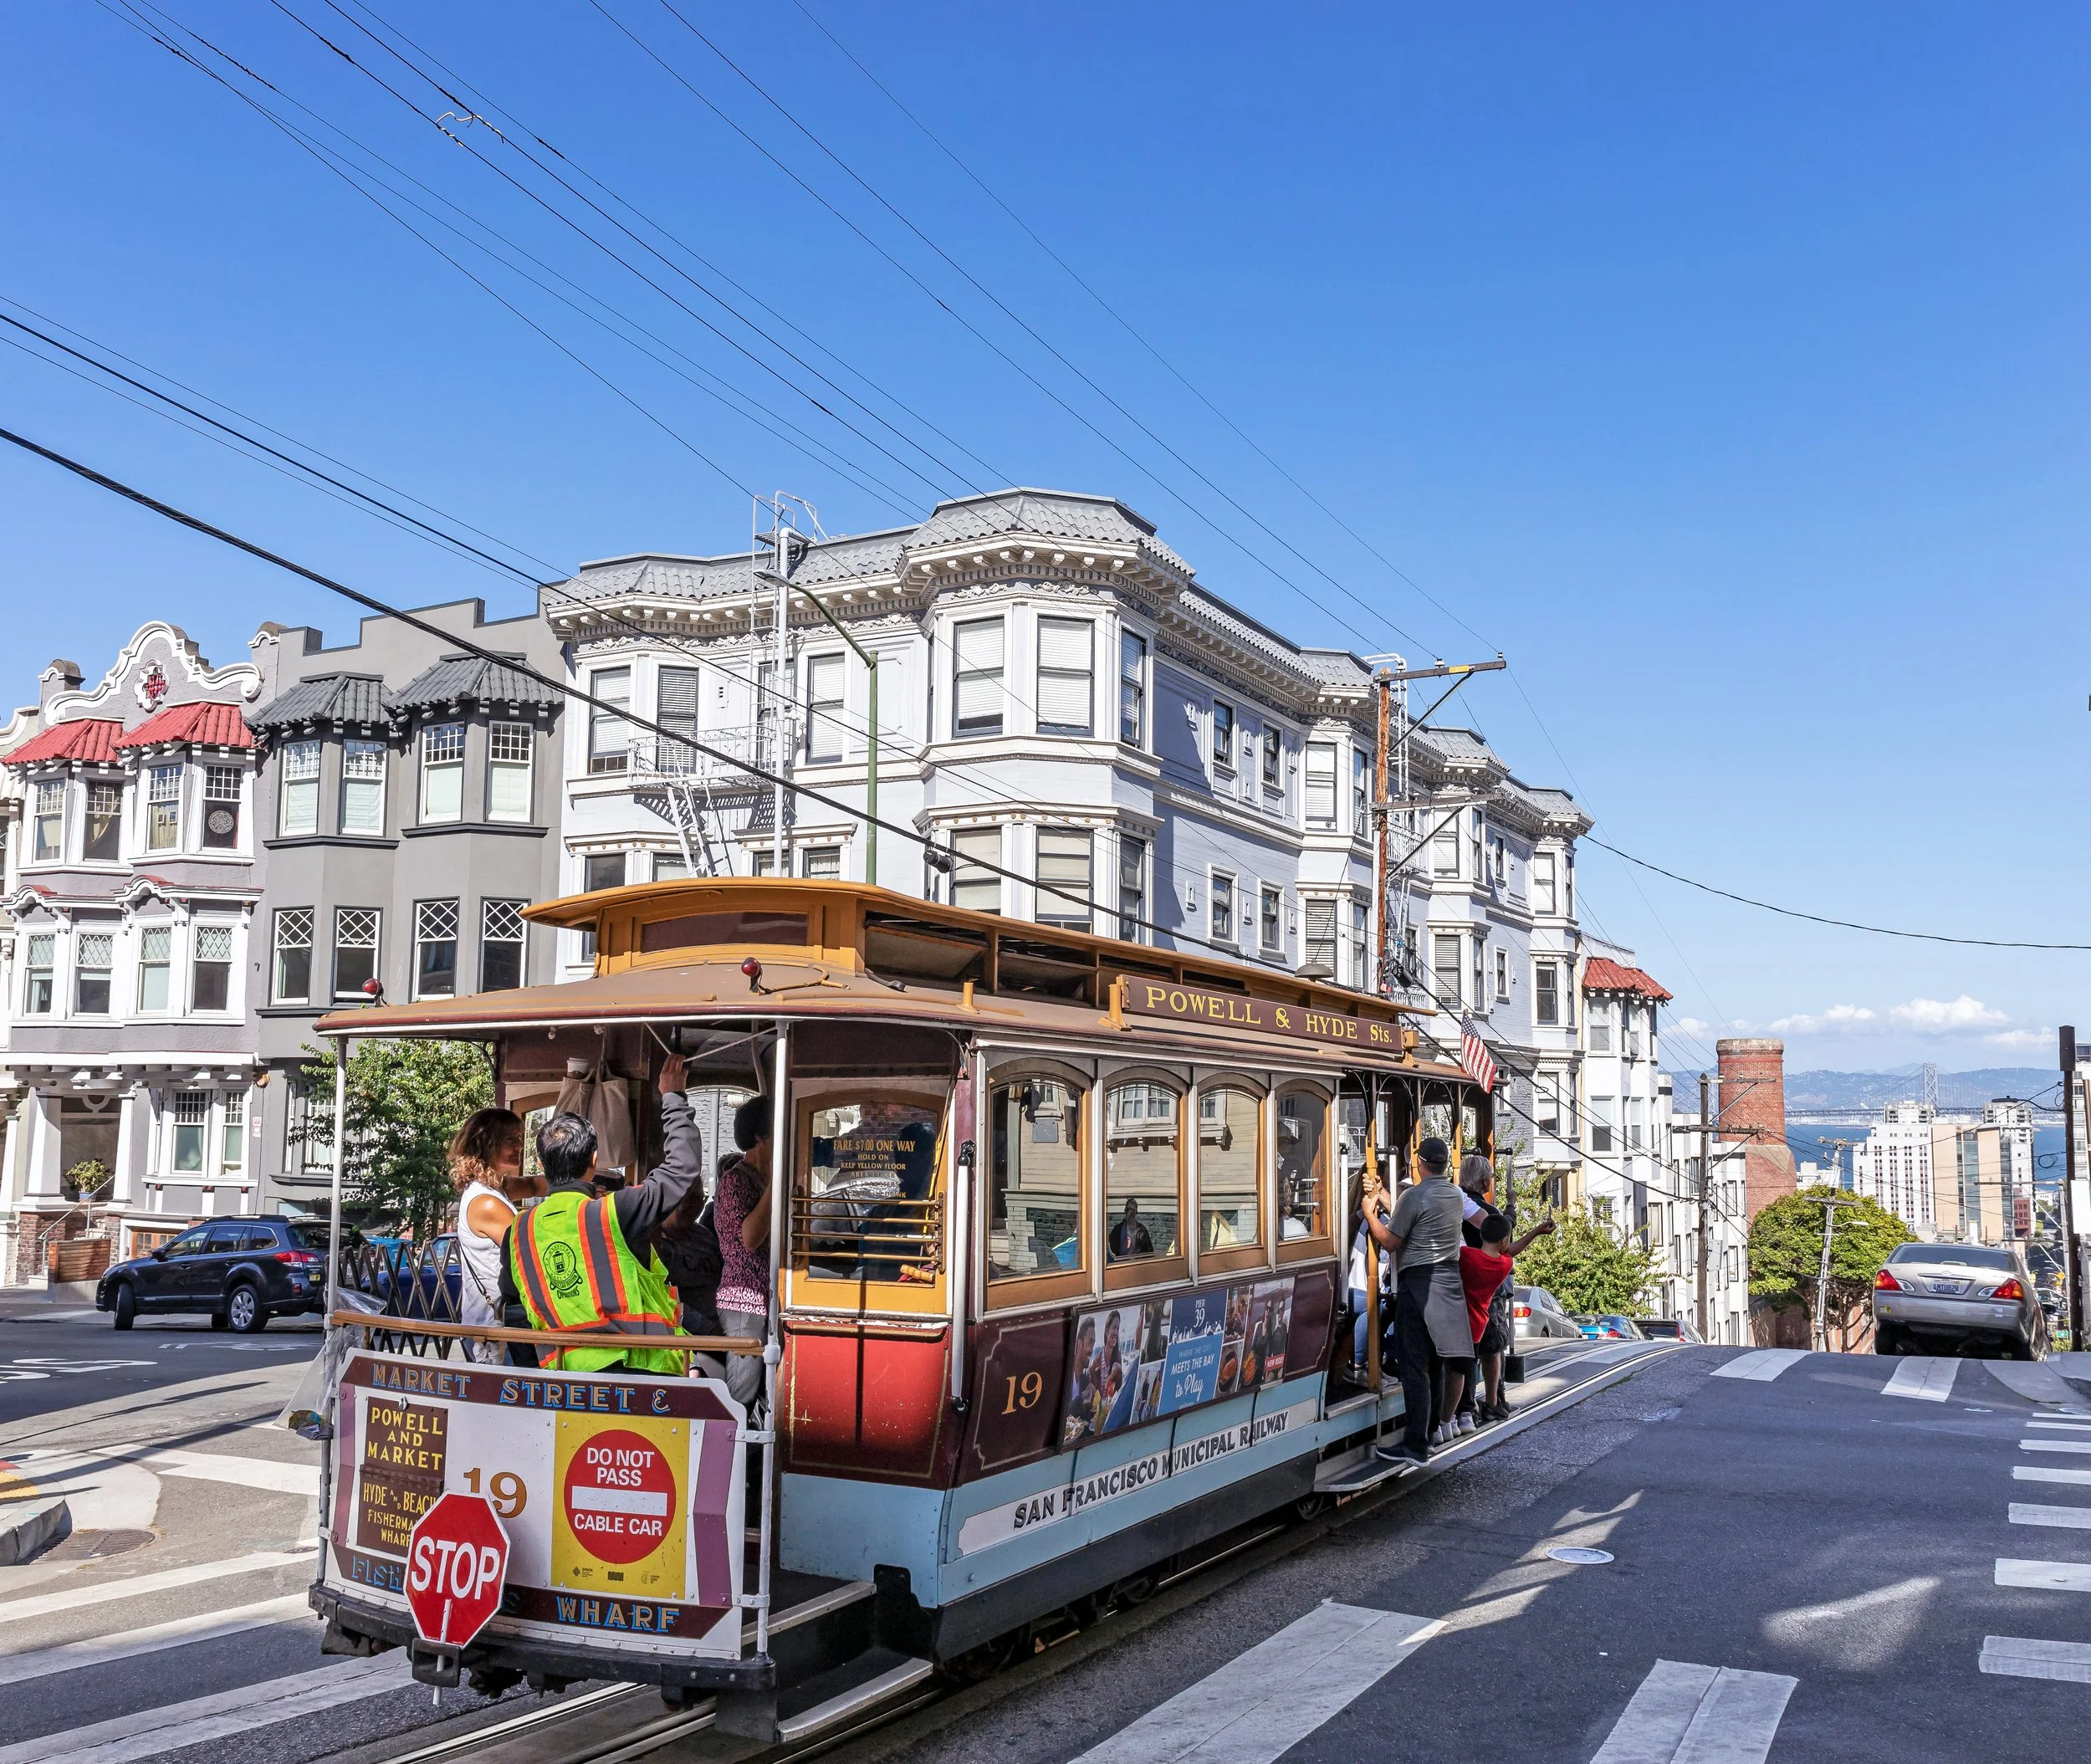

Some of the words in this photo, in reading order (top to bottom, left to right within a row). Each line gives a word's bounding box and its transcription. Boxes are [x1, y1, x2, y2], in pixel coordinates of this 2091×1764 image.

[1145, 985, 1261, 1025] POWELL
[1276, 1007, 1291, 1030] &
[1305, 1013, 1358, 1040] HYDE
[1370, 1024, 1393, 1044] Sts.
[833, 1139, 853, 1151] FARE
[855, 1139, 874, 1152] $7.00
[876, 1140, 894, 1152] ONE
[897, 1140, 916, 1153] WAY
[1195, 1299, 1206, 1308] PIER
[1193, 1307, 1205, 1328] 39
[1171, 1360, 1191, 1376] MEETS
[1191, 1358, 1202, 1370] THE
[1203, 1353, 1215, 1368] BAY
[371, 1363, 471, 1398] MARKET
[499, 1377, 636, 1414] STREET
[1001, 1372, 1043, 1415] 19
[1184, 1373, 1204, 1402] Play
[371, 1407, 443, 1436] POWELL
[386, 1429, 424, 1448] AND
[367, 1440, 443, 1471] MARKET
[586, 1447, 613, 1465] DO
[616, 1449, 655, 1469] NOT
[596, 1466, 642, 1487] PASS
[1013, 1493, 1056, 1531] SAN
[1061, 1457, 1158, 1513] FRANCISCO
[1161, 1430, 1235, 1477] MUNICIPAL
[1240, 1410, 1290, 1447] RAILWAY
[362, 1482, 388, 1507] HYDE
[574, 1513, 624, 1534] CABLE
[629, 1518, 662, 1536] CAR
[411, 1536, 501, 1601] STOP
[556, 1594, 681, 1634] WHARF
